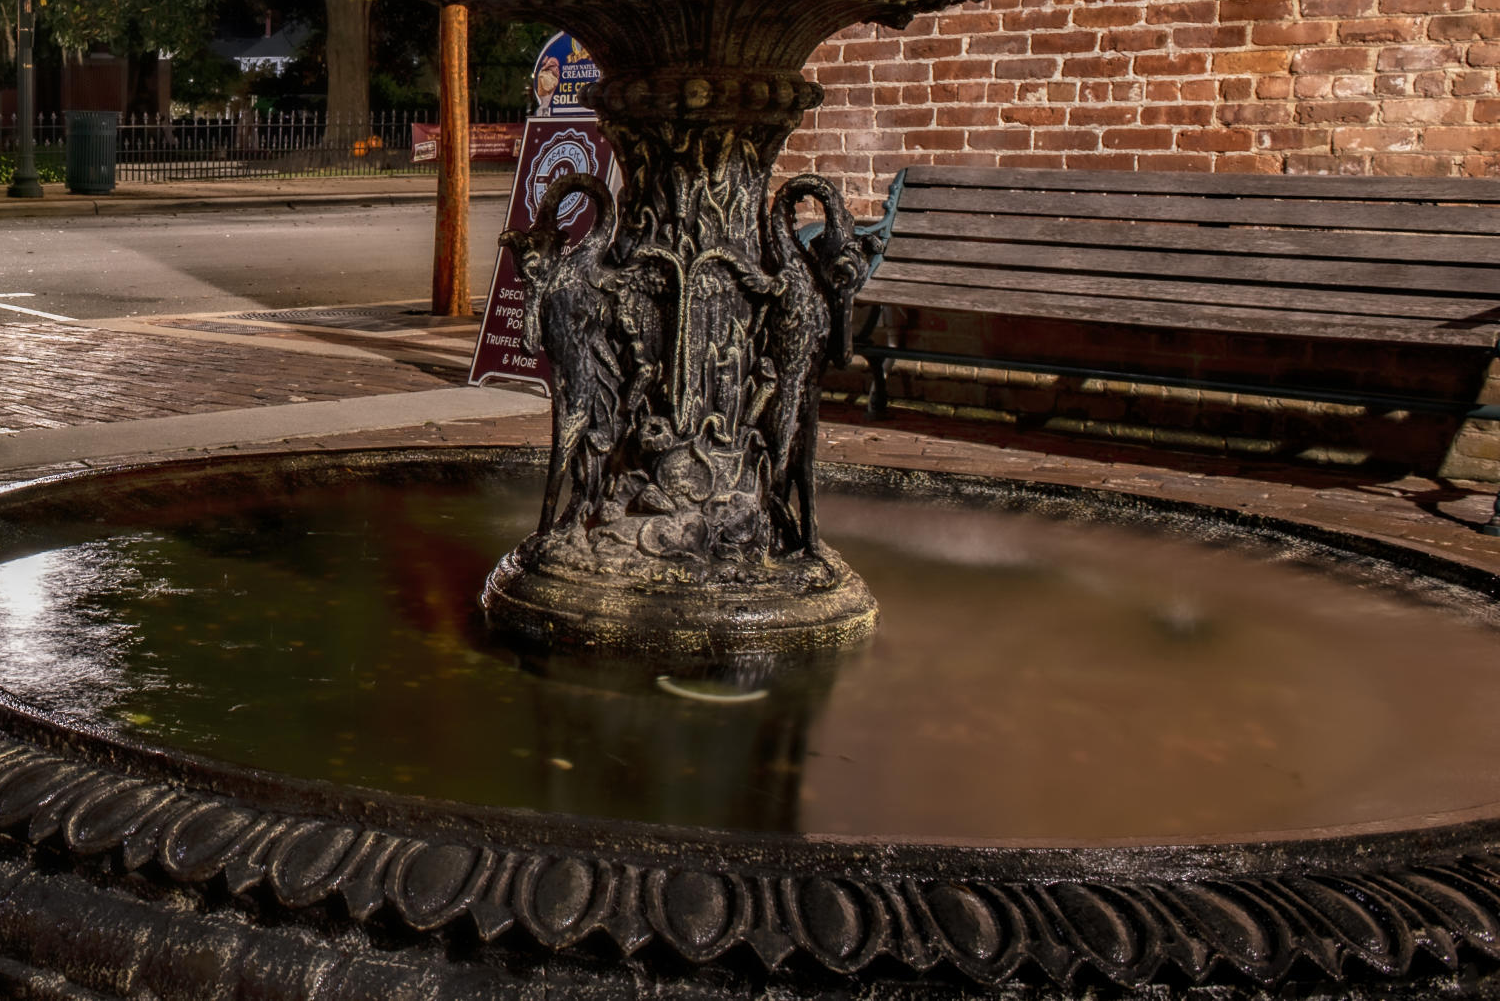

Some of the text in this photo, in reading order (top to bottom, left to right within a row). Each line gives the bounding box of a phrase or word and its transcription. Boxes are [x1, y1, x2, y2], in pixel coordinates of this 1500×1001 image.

[559, 82, 572, 93] ICE
[568, 147, 583, 167] CITY
[499, 287, 524, 300] SPECI
[502, 353, 538, 369] & MORE
